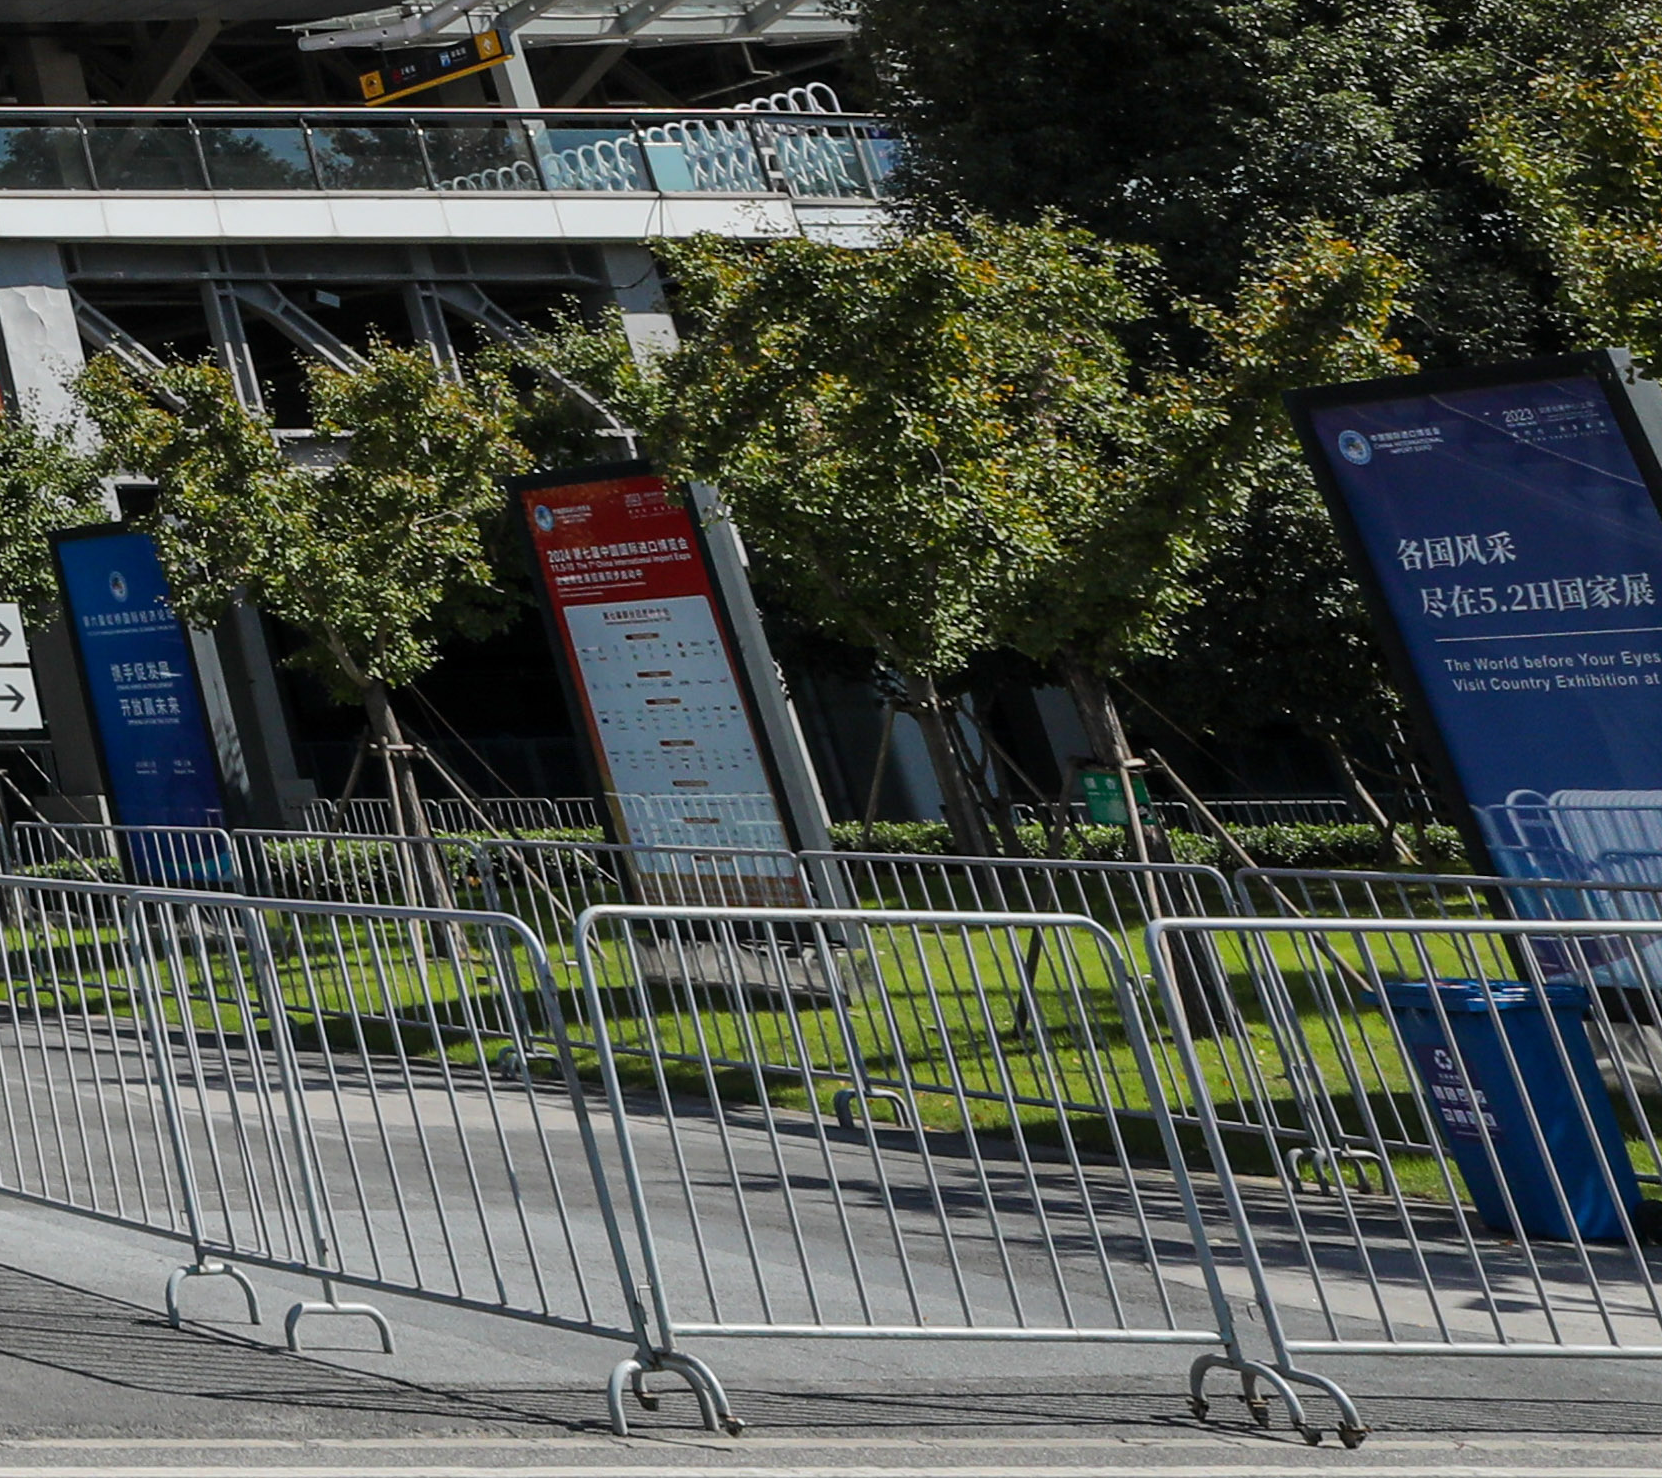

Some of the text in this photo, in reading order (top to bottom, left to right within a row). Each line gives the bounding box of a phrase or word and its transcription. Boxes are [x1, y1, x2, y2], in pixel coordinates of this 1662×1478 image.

[1502, 408, 1534, 423] 2023
[1397, 531, 1516, 571] 各国风采
[1420, 572, 1656, 619] 尽在5.2H国家展
[1444, 650, 1661, 672] The World before Your Eyes
[1452, 673, 1661, 692] Visit Country Exhibition at
[119, 696, 181, 717] 开放赢未来
